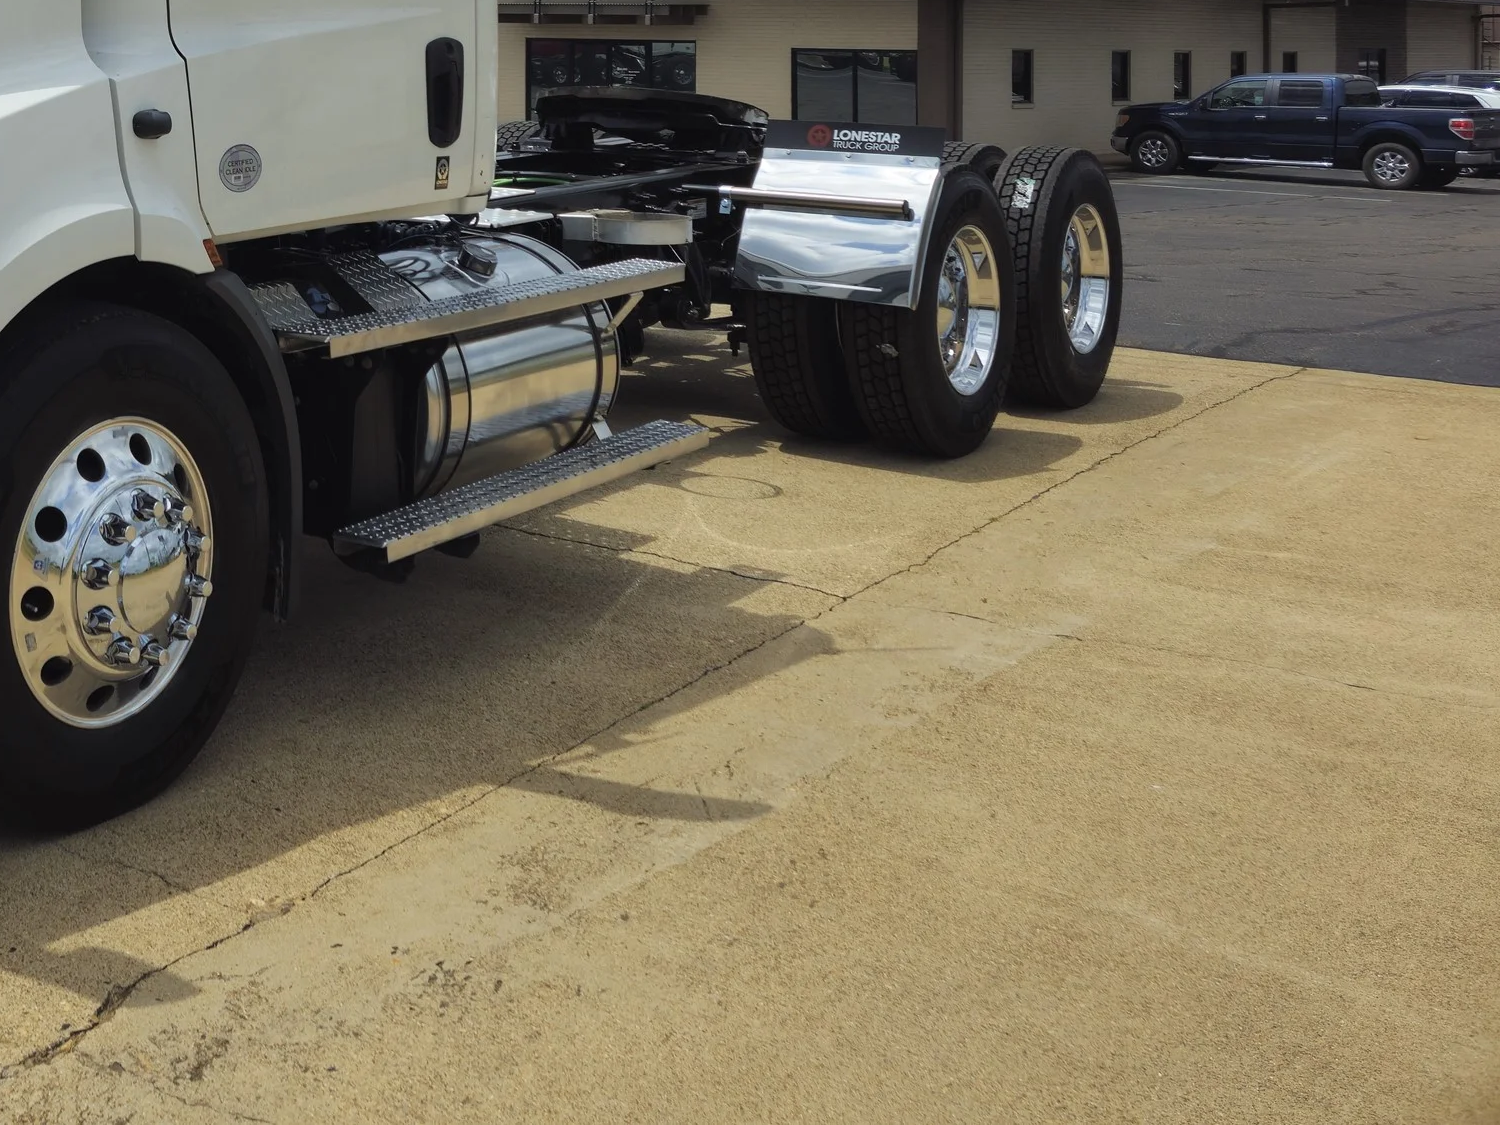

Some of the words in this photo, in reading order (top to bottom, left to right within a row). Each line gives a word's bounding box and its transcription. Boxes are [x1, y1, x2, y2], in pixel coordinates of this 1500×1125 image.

[832, 129, 901, 144] LONESTAR
[832, 140, 862, 150] TRUCK
[864, 142, 900, 152] GROUP
[227, 158, 254, 167] CERTIFIED
[225, 167, 243, 176] CLEAN
[244, 165, 257, 173] IDLE
